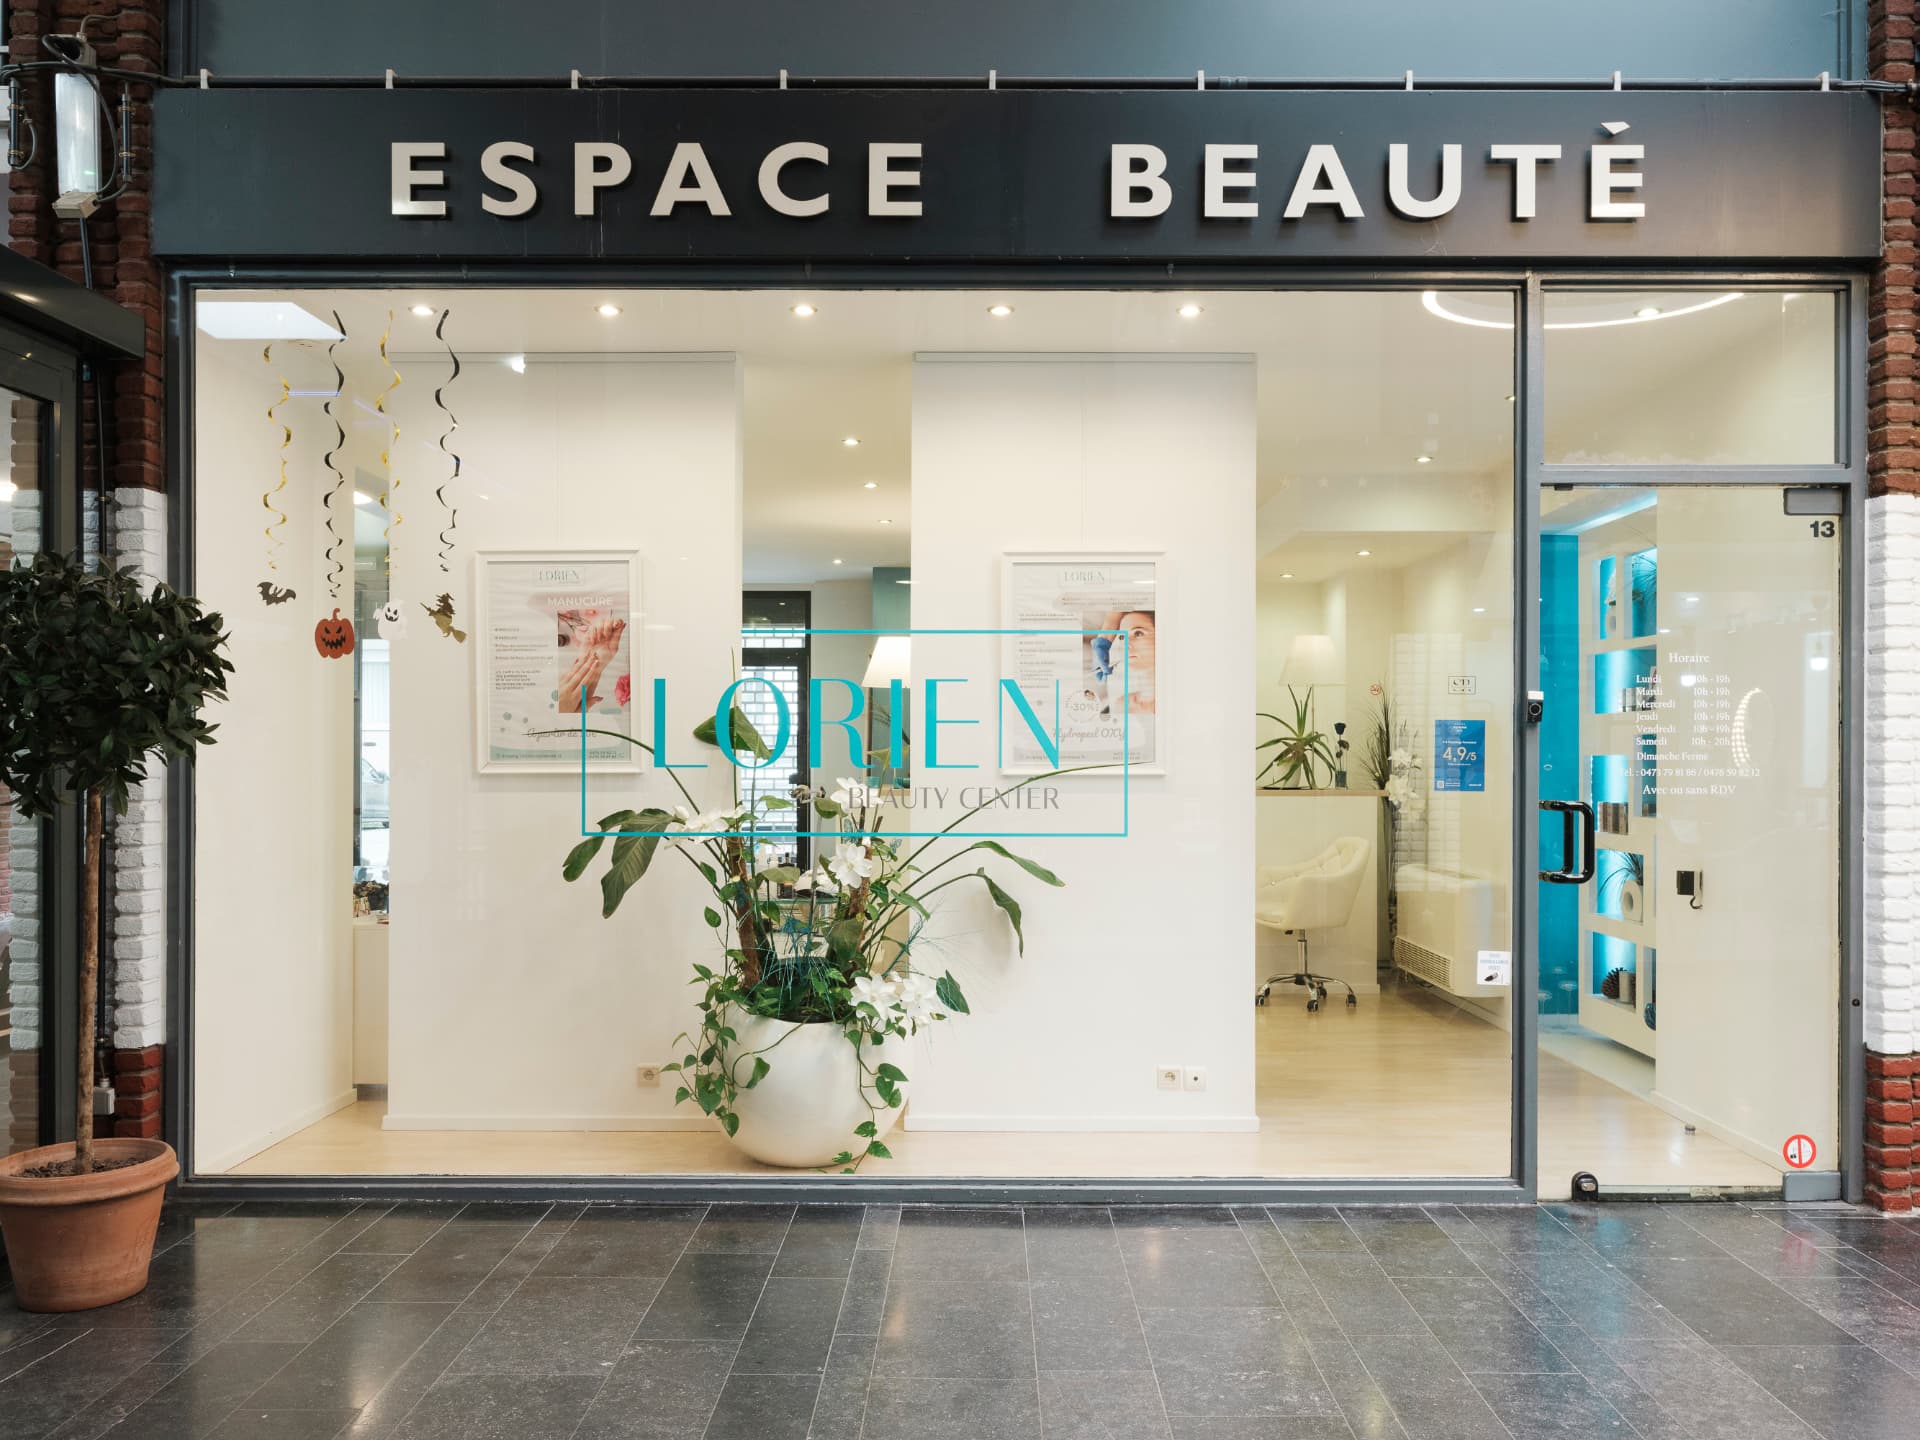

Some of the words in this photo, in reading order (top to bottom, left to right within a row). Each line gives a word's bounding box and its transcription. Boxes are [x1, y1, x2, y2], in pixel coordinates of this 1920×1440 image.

[391, 141, 922, 216] ESPACE
[1110, 121, 1646, 218] BEAUTÉ
[1810, 520, 1835, 538] 13
[547, 595, 614, 607] MANUCURE
[1668, 651, 1711, 663] Horaire
[1636, 674, 1662, 683] Lundi
[1636, 686, 1663, 696] Mardi
[1694, 687, 1708, 696] 10h
[1715, 687, 1730, 696] 19h
[1636, 699, 1676, 709] Mercredi
[1635, 711, 1658, 722] Jeudi
[653, 677, 1060, 770] LORIEN
[1635, 723, 1676, 734] Vendredi
[1635, 736, 1667, 746] Samedi
[1691, 736, 1706, 745] 10h
[1714, 736, 1730, 745] 20h
[1636, 751, 1680, 761] Dimanche
[1643, 785, 1667, 795] Avec
[1670, 787, 1683, 795] ou
[1686, 786, 1708, 795] sans
[1711, 785, 1736, 795] RDV
[849, 787, 949, 809] BEAUTY
[959, 787, 1060, 810] CENTER
